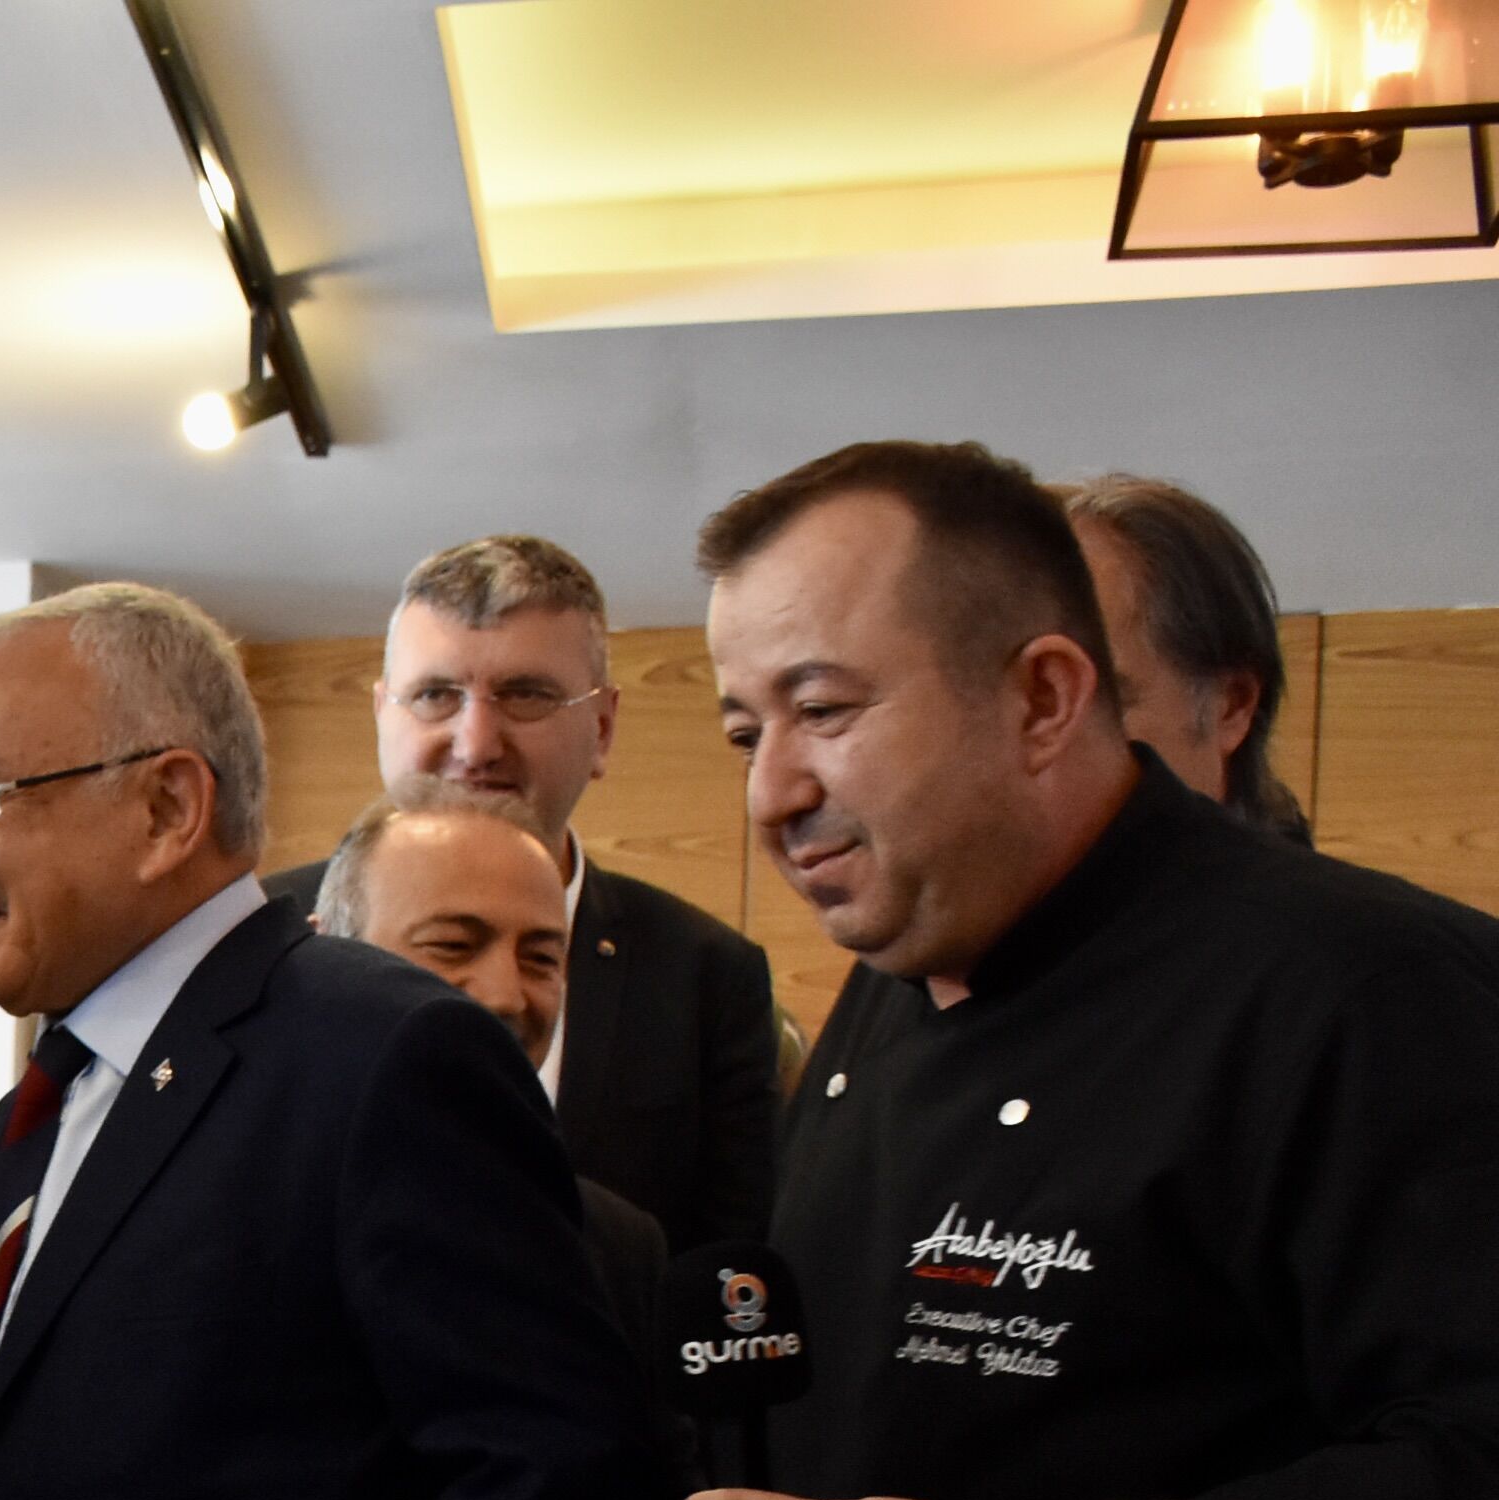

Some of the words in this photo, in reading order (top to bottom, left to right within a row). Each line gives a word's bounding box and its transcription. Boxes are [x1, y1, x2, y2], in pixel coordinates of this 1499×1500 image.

[904, 1201, 1095, 1290] Atabeyoğlu
[904, 1302, 1003, 1334] Executive
[1004, 1315, 1074, 1348] Chef
[680, 1332, 801, 1375] gurme
